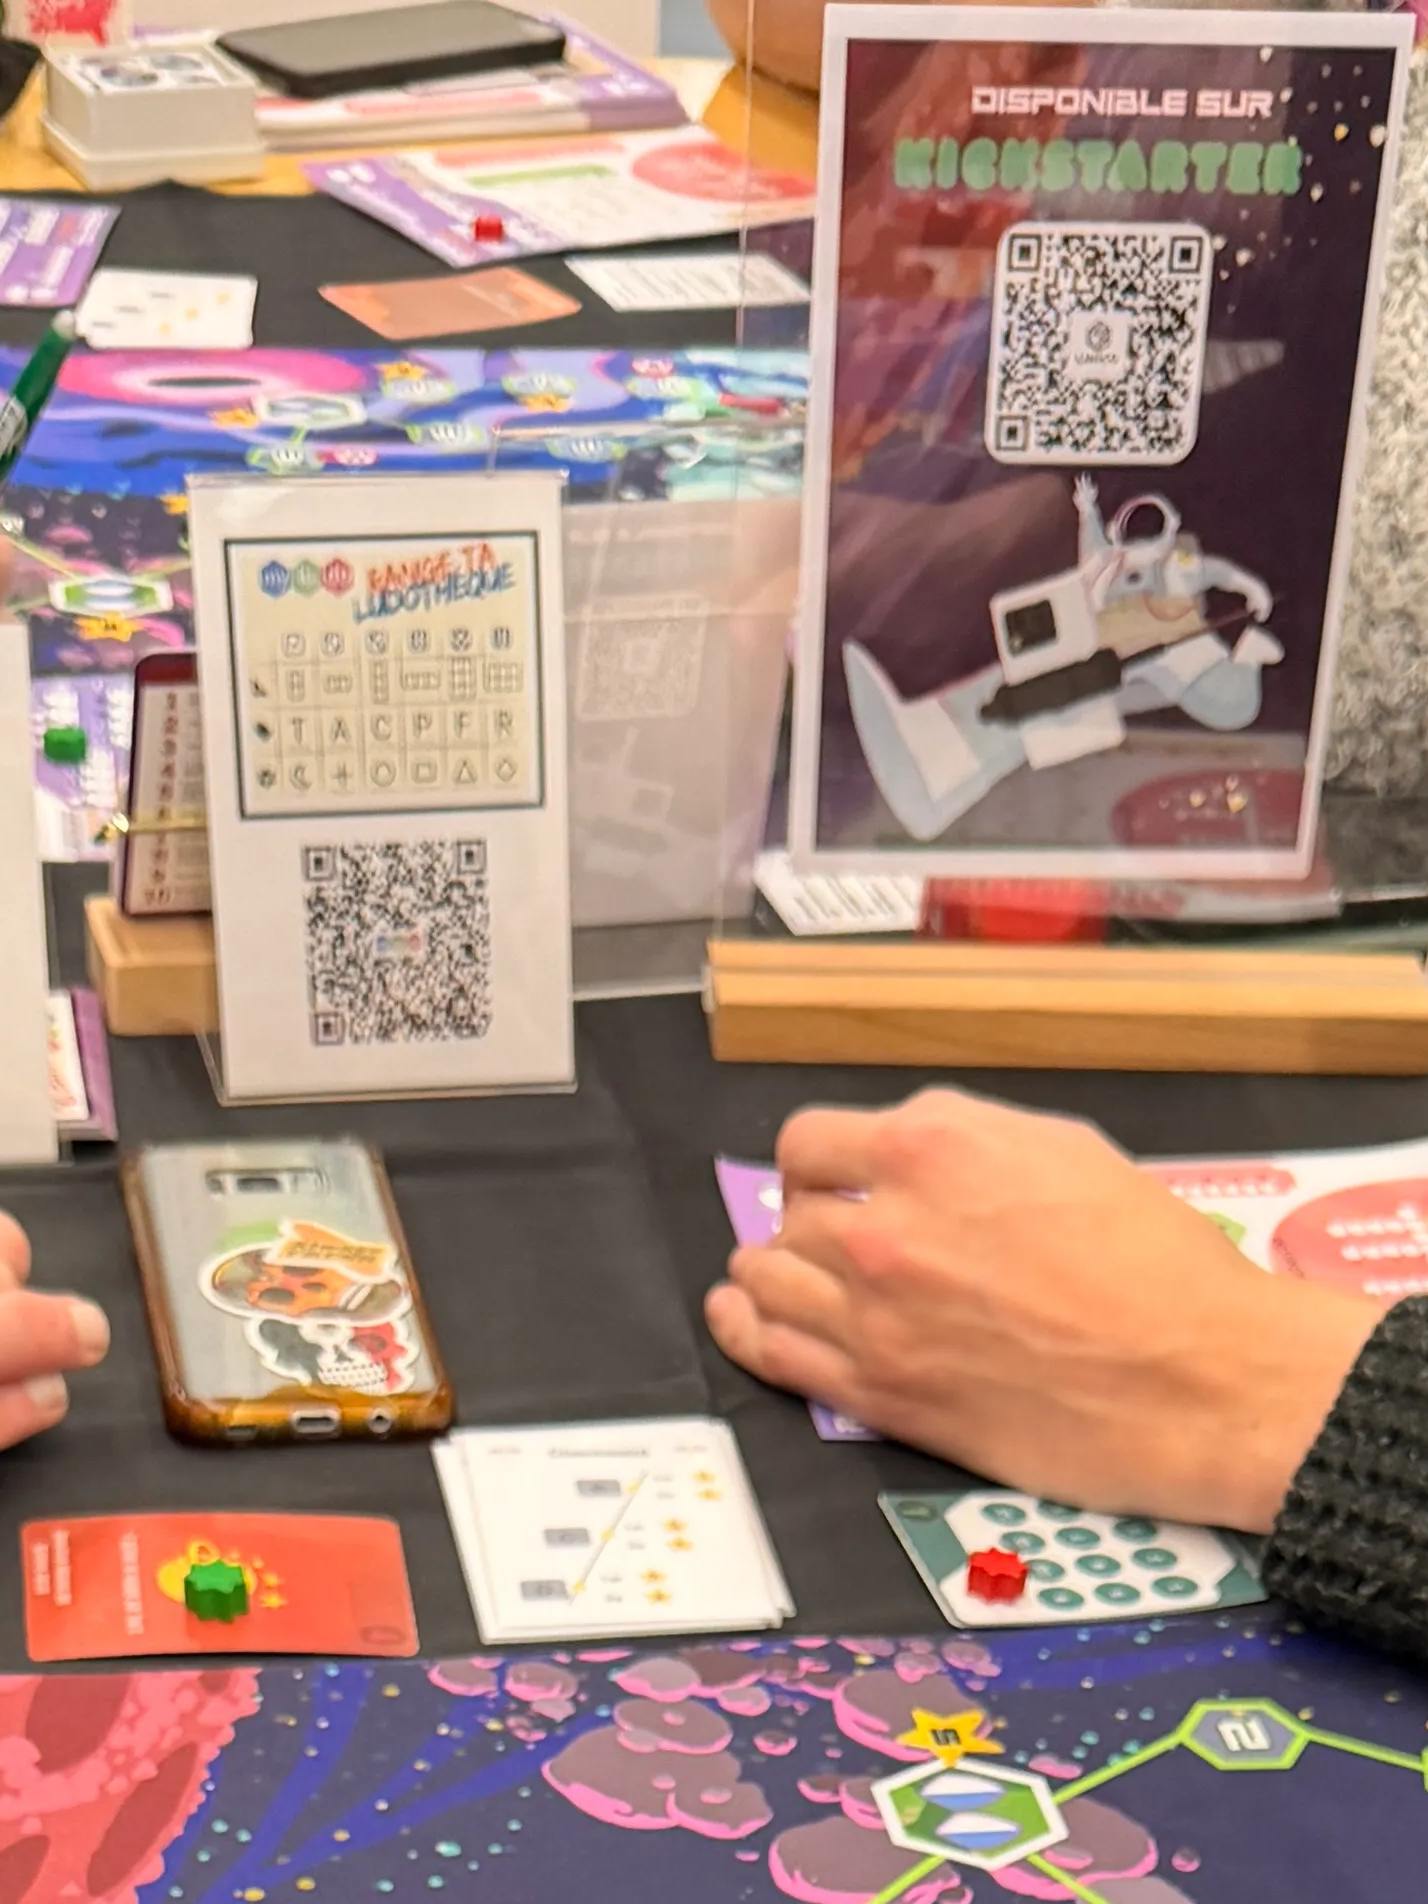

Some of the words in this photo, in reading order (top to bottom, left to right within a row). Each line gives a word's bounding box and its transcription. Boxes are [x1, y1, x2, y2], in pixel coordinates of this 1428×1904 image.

[972, 86, 1187, 117] DISPONIBLE
[1195, 89, 1274, 119] SUR
[892, 136, 1303, 195] KICKSTARTER
[1218, 1719, 1270, 1753] 2
